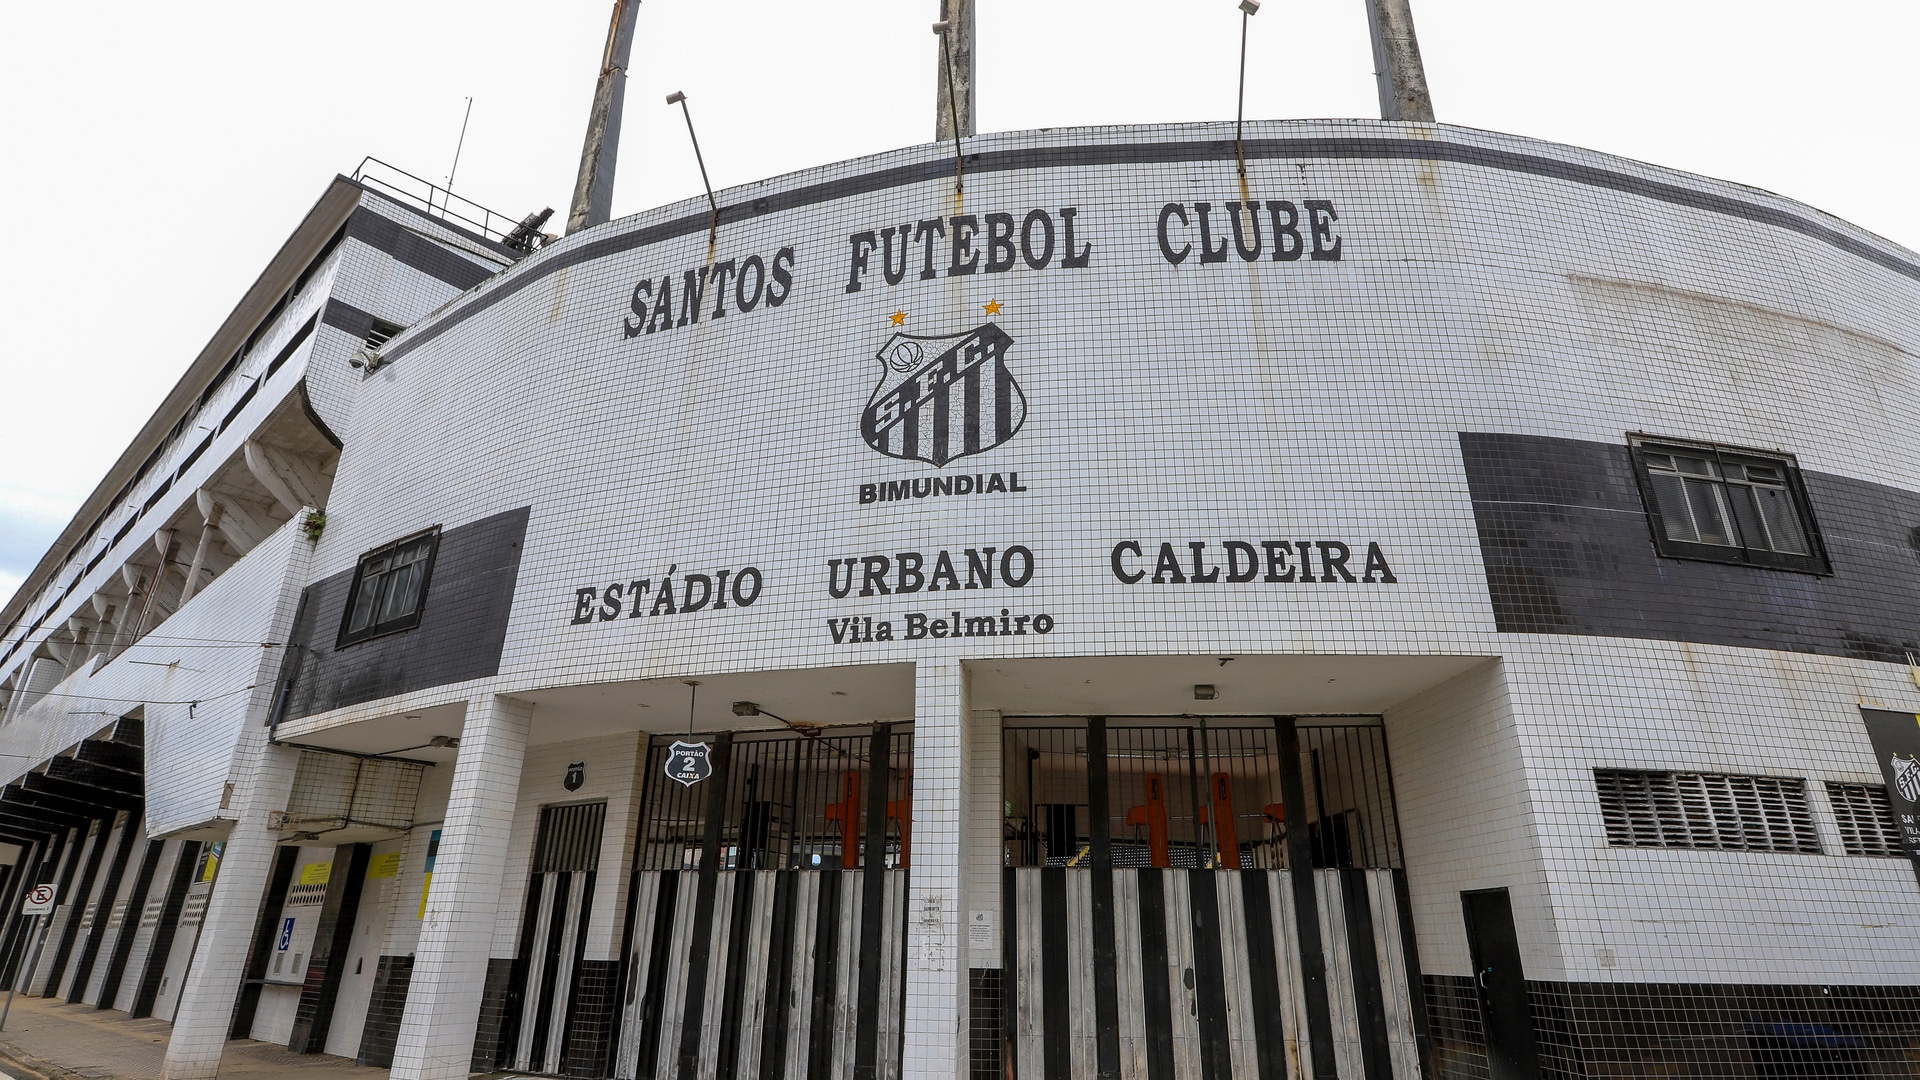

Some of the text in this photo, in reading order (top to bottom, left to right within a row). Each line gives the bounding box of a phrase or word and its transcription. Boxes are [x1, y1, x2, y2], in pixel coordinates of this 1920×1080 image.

[623, 200, 1342, 340] SANTOS FUTEBOL CLUBE
[858, 472, 1027, 504] BIMUNDIAL
[570, 540, 1398, 625] ESTÁDIO URBANO CALDEIRA
[827, 608, 1054, 644] Vila Belmiro
[571, 771, 577, 783] 1
[682, 756, 696, 772] 2
